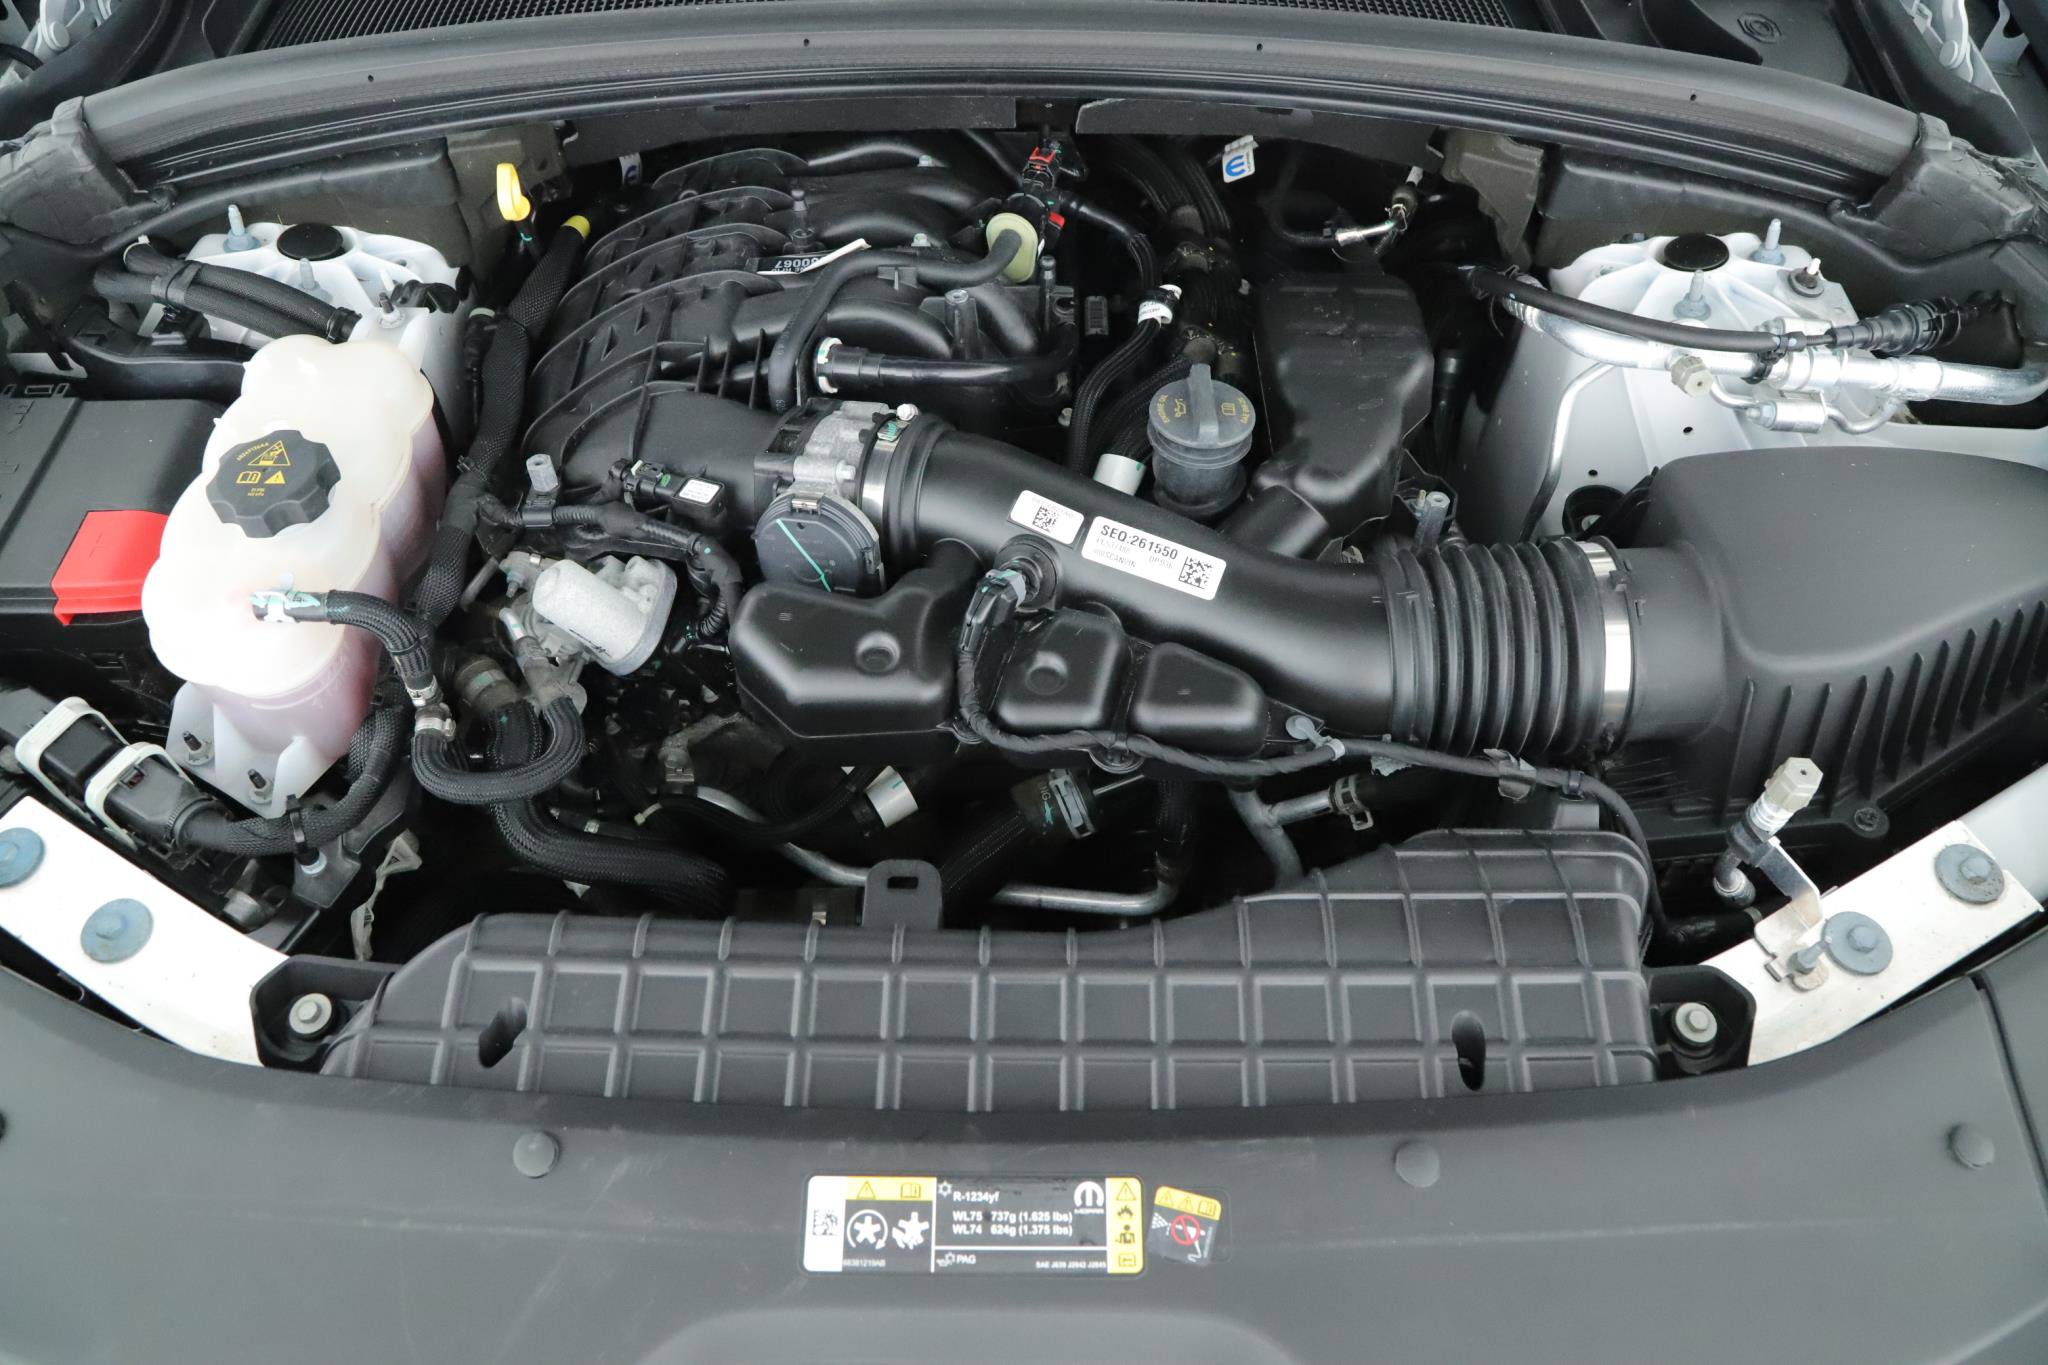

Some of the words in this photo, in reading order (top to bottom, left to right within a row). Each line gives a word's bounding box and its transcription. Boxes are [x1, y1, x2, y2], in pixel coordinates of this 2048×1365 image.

[953, 1190, 1000, 1204] R-1234yf
[952, 1210, 983, 1221] WL75
[991, 1211, 1017, 1224] 737g
[1019, 1211, 1051, 1223] (1.625
[1052, 1211, 1073, 1223] lbs)
[952, 1224, 983, 1235] WL74
[990, 1224, 1017, 1237] 624g
[1018, 1224, 1051, 1237] (1.375
[1052, 1224, 1073, 1237] lbs)
[956, 1255, 977, 1265] PAG
